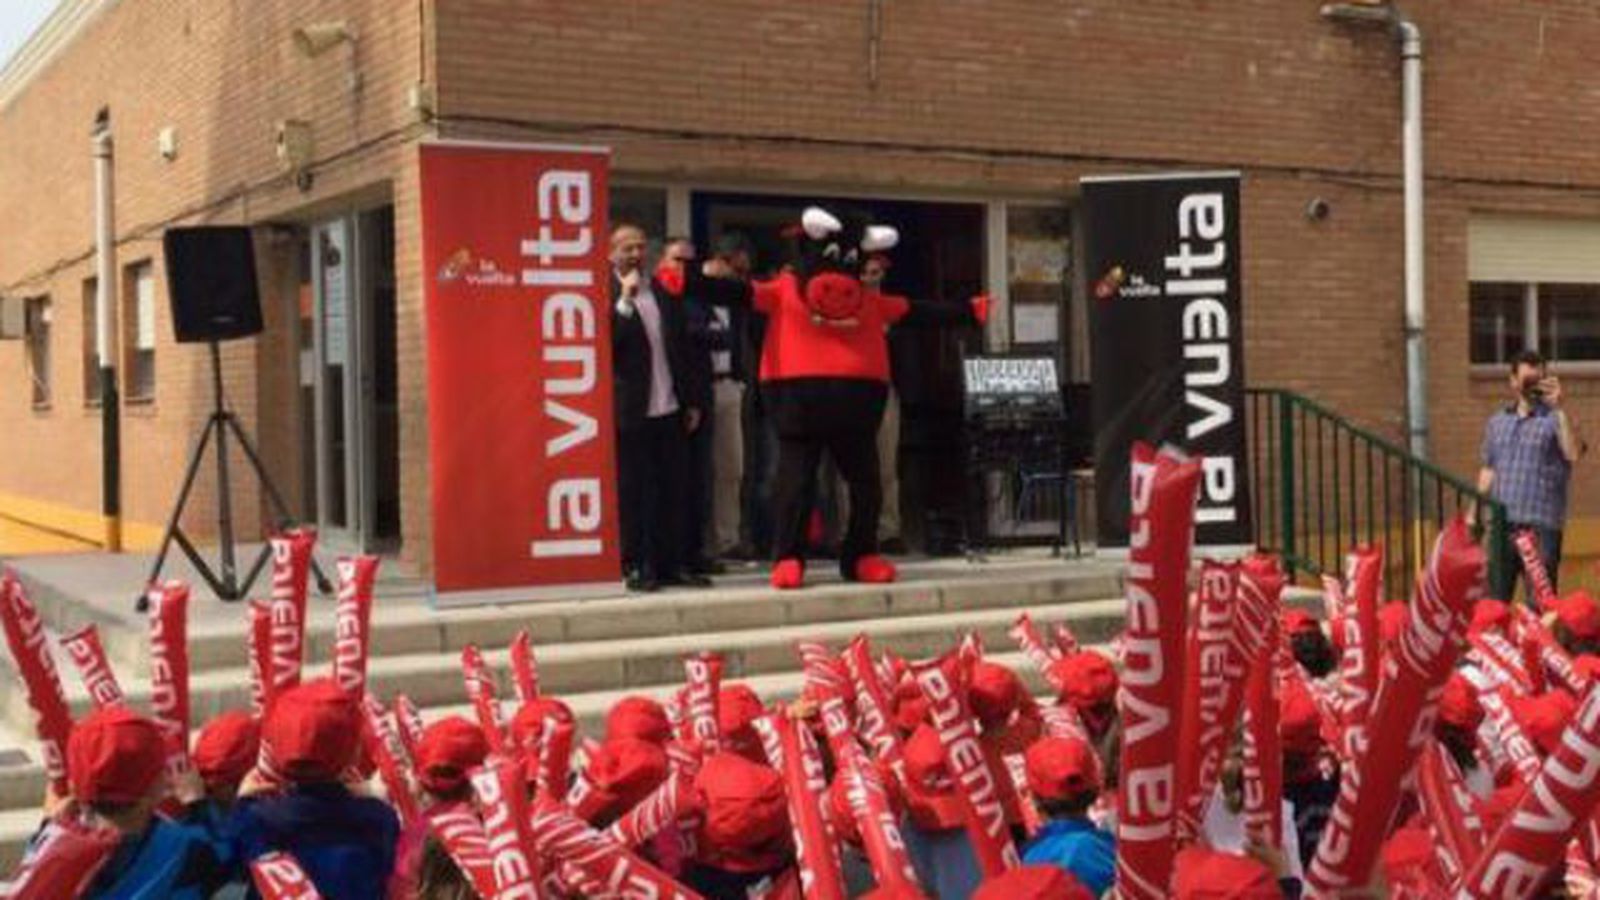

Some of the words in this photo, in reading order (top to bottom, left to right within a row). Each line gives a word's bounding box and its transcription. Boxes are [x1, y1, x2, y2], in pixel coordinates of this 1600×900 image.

[521, 168, 598, 458] vuelta
[1164, 192, 1234, 441] vuelta
[531, 477, 602, 558] la
[1119, 762, 1174, 842] la
